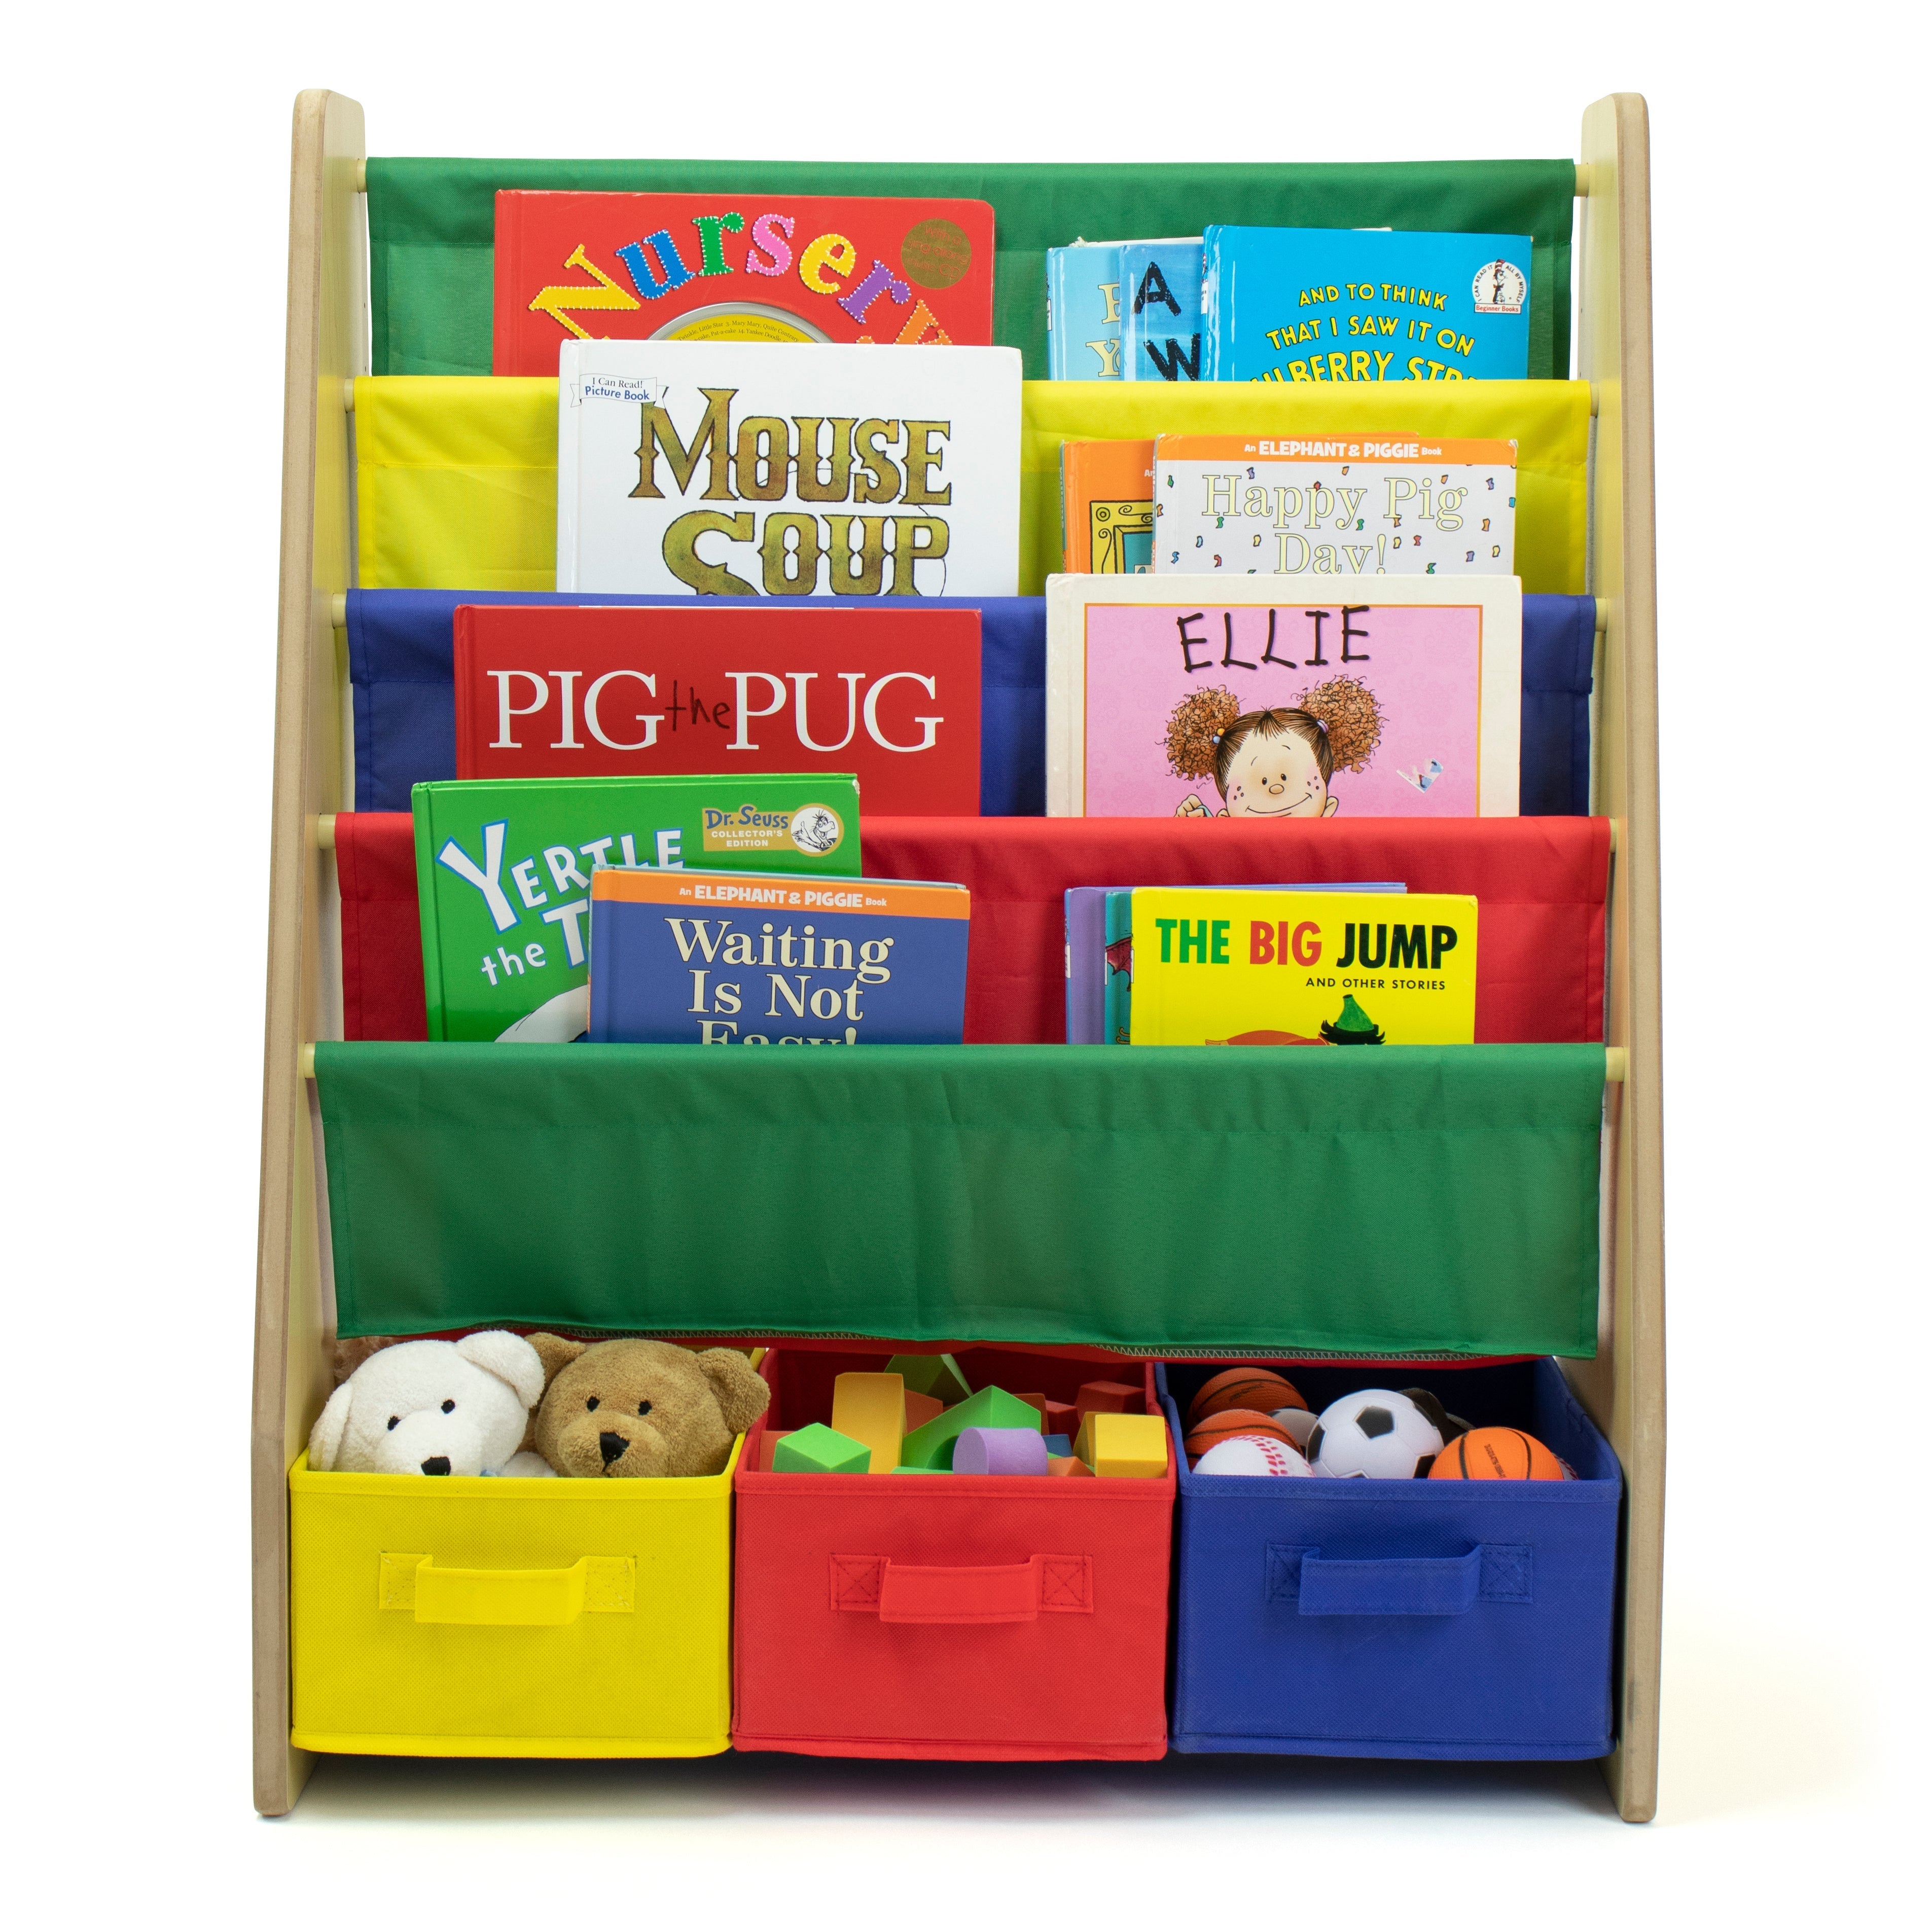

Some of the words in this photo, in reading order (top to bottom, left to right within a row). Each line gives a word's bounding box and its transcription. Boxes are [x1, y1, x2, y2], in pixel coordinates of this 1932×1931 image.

[939, 264, 961, 278] CD
[1475, 269, 1487, 282] READ
[1506, 265, 1515, 273] ALL
[1516, 281, 1524, 303] MYSELF
[1299, 285, 1340, 307] AND
[1346, 283, 1375, 301] TO
[1380, 283, 1449, 311] THINK
[763, 323, 777, 332] Quite
[777, 329, 799, 342] Contrary
[764, 332, 781, 342] Doodle
[1266, 319, 1321, 350] THAT
[1330, 316, 1338, 337] I
[1348, 315, 1400, 336] SAW
[1407, 319, 1433, 342] IT
[1436, 328, 1476, 357] ON
[585, 385, 621, 398] Picture
[624, 389, 650, 400] Book
[598, 377, 616, 387] Can
[618, 379, 643, 389] Read!
[627, 387, 952, 505] MOUSE
[1244, 444, 1256, 453] An
[1259, 441, 1347, 457] ELEPHANT
[1348, 445, 1361, 456] &
[1364, 443, 1420, 458] PIGGIE
[1421, 447, 1442, 456] Book
[1201, 475, 1368, 529] Happy
[1383, 477, 1468, 532] Pig
[662, 509, 950, 596] SOUP
[1274, 532, 1387, 574] Day!
[1176, 605, 1371, 673] ELLIE
[487, 670, 665, 750] PIG
[665, 680, 730, 732] the
[725, 672, 944, 752] PUG
[705, 810, 734, 829] Dr.
[738, 806, 789, 829] Seuss
[711, 829, 783, 838] COLLECTOR'S
[436, 818, 686, 935] YERTLE
[679, 887, 692, 896] An
[695, 885, 787, 904] ELEPHANT
[789, 892, 801, 904] &
[804, 890, 863, 908] PIGGIE
[866, 898, 887, 906] Book
[664, 918, 895, 985] Waiting
[1155, 918, 1230, 964] THE
[1249, 920, 1322, 967] BIG
[1336, 923, 1458, 969] JUMP
[481, 942, 546, 986] the
[1305, 977, 1336, 988] AND
[1342, 978, 1386, 989] OTHER
[1392, 979, 1447, 991] STORIES
[687, 968, 742, 1015] Is
[765, 973, 864, 1022] Not
